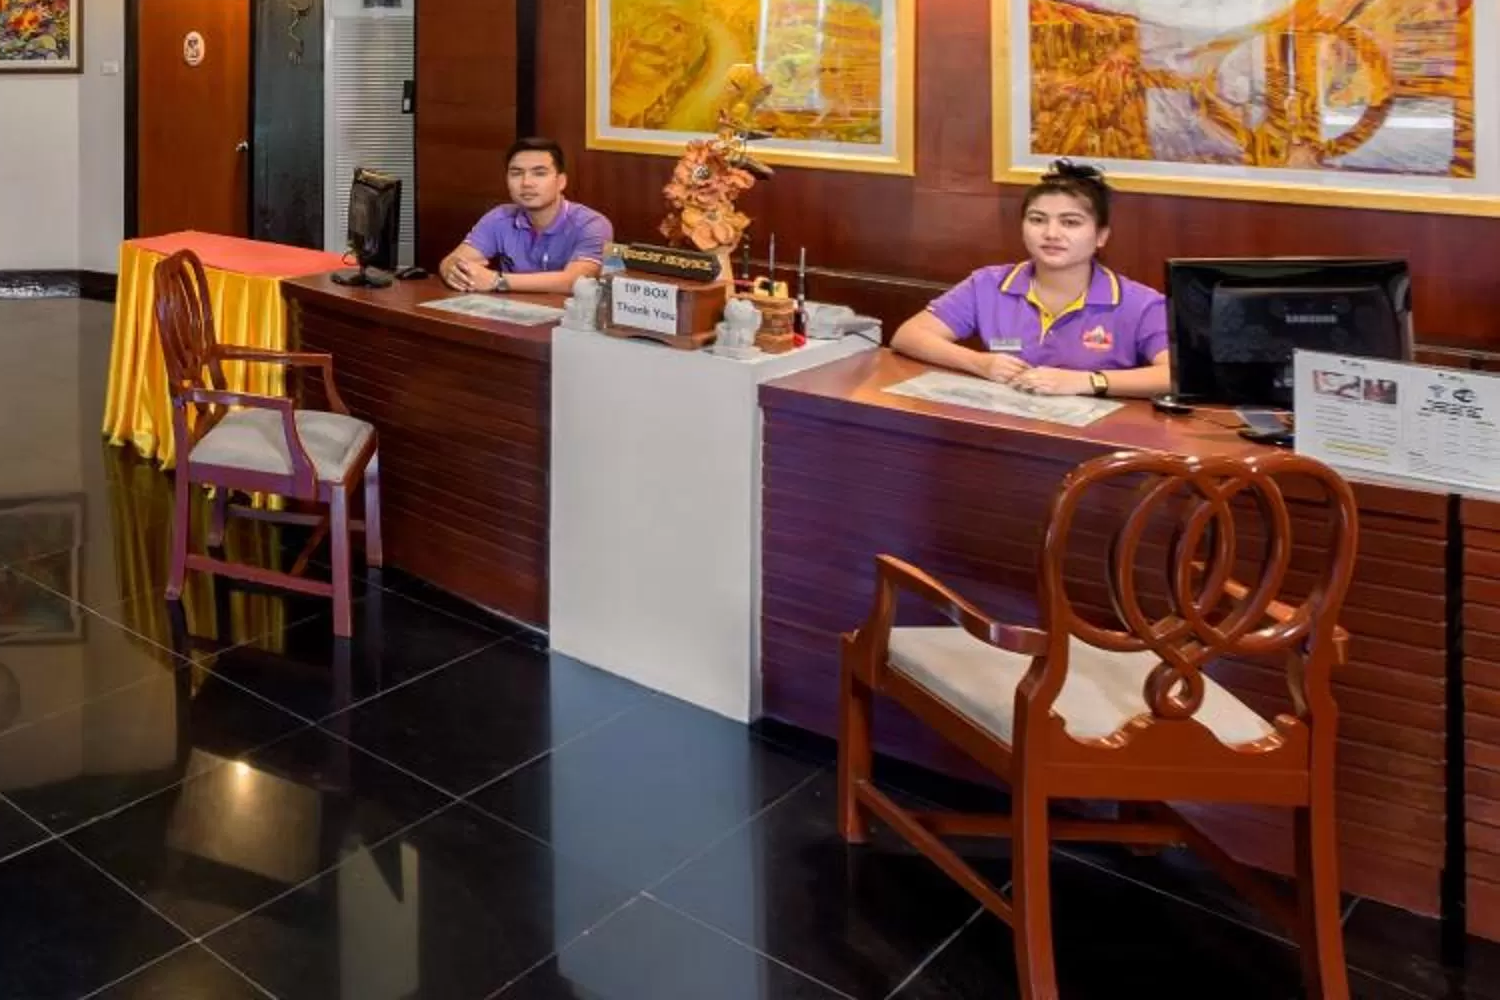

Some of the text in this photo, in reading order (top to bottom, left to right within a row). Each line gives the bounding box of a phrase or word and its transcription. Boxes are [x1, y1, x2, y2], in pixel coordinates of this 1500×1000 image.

[624, 283, 669, 299] TIP BOX
[616, 301, 676, 321] Thank You
